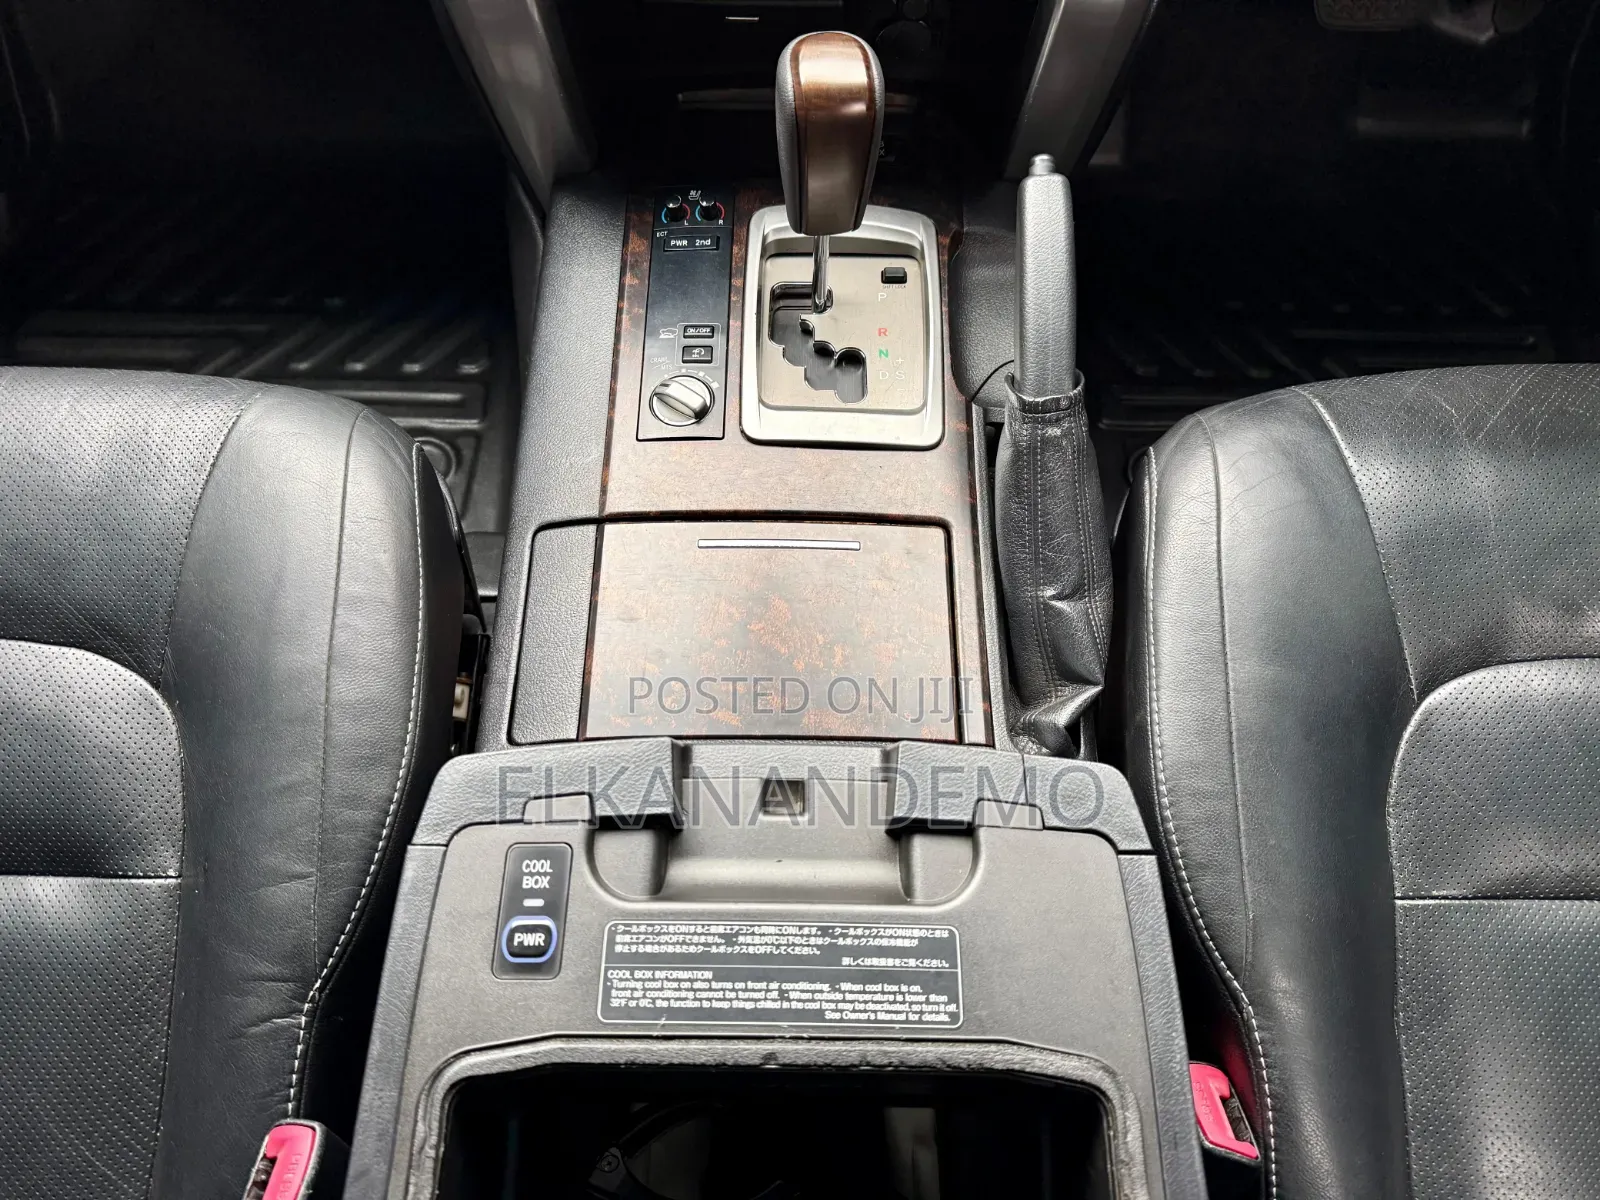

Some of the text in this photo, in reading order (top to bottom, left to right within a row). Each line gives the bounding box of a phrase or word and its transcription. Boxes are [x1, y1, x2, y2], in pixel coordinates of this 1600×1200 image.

[695, 238, 711, 246] 2nd
[878, 292, 887, 302] P
[877, 327, 888, 337] R
[878, 349, 889, 359] N
[879, 370, 905, 380] D S
[522, 859, 553, 873] COOL
[521, 875, 551, 889] BOX
[513, 932, 546, 947] PWR
[607, 970, 713, 980] COOL BOX INFORMATION
[612, 980, 643, 989] Turning
[644, 980, 662, 988] cool
[663, 980, 679, 988] box
[692, 981, 709, 989] also
[747, 981, 767, 989] front
[768, 982, 780, 990] air
[840, 983, 863, 991] When
[865, 984, 882, 992] cool
[884, 984, 899, 992] box
[901, 984, 908, 992] is
[611, 989, 632, 998] front
[633, 989, 644, 998] air
[646, 990, 694, 998] conditioning
[738, 991, 765, 999] turned
[766, 991, 780, 999] off.
[789, 991, 812, 1000] When
[814, 992, 843, 1000] outside
[845, 992, 894, 1001] temperature
[896, 993, 904, 1001] is
[905, 994, 927, 1002] lower
[929, 994, 948, 1002] than
[656, 999, 669, 1007] the
[670, 999, 700, 1007] function
[702, 1000, 710, 1008] to
[712, 1000, 731, 1009] keep
[732, 1000, 755, 1009] things
[782, 1001, 790, 1009] in
[791, 1001, 804, 1009] the
[805, 1001, 820, 1009] cool
[822, 1001, 836, 1009] box
[838, 1003, 854, 1011] may
[855, 1002, 865, 1010] be
[946, 1004, 958, 1012] off.
[825, 1011, 841, 1019] See
[877, 1012, 906, 1020] Manual
[922, 1013, 950, 1021] details.
